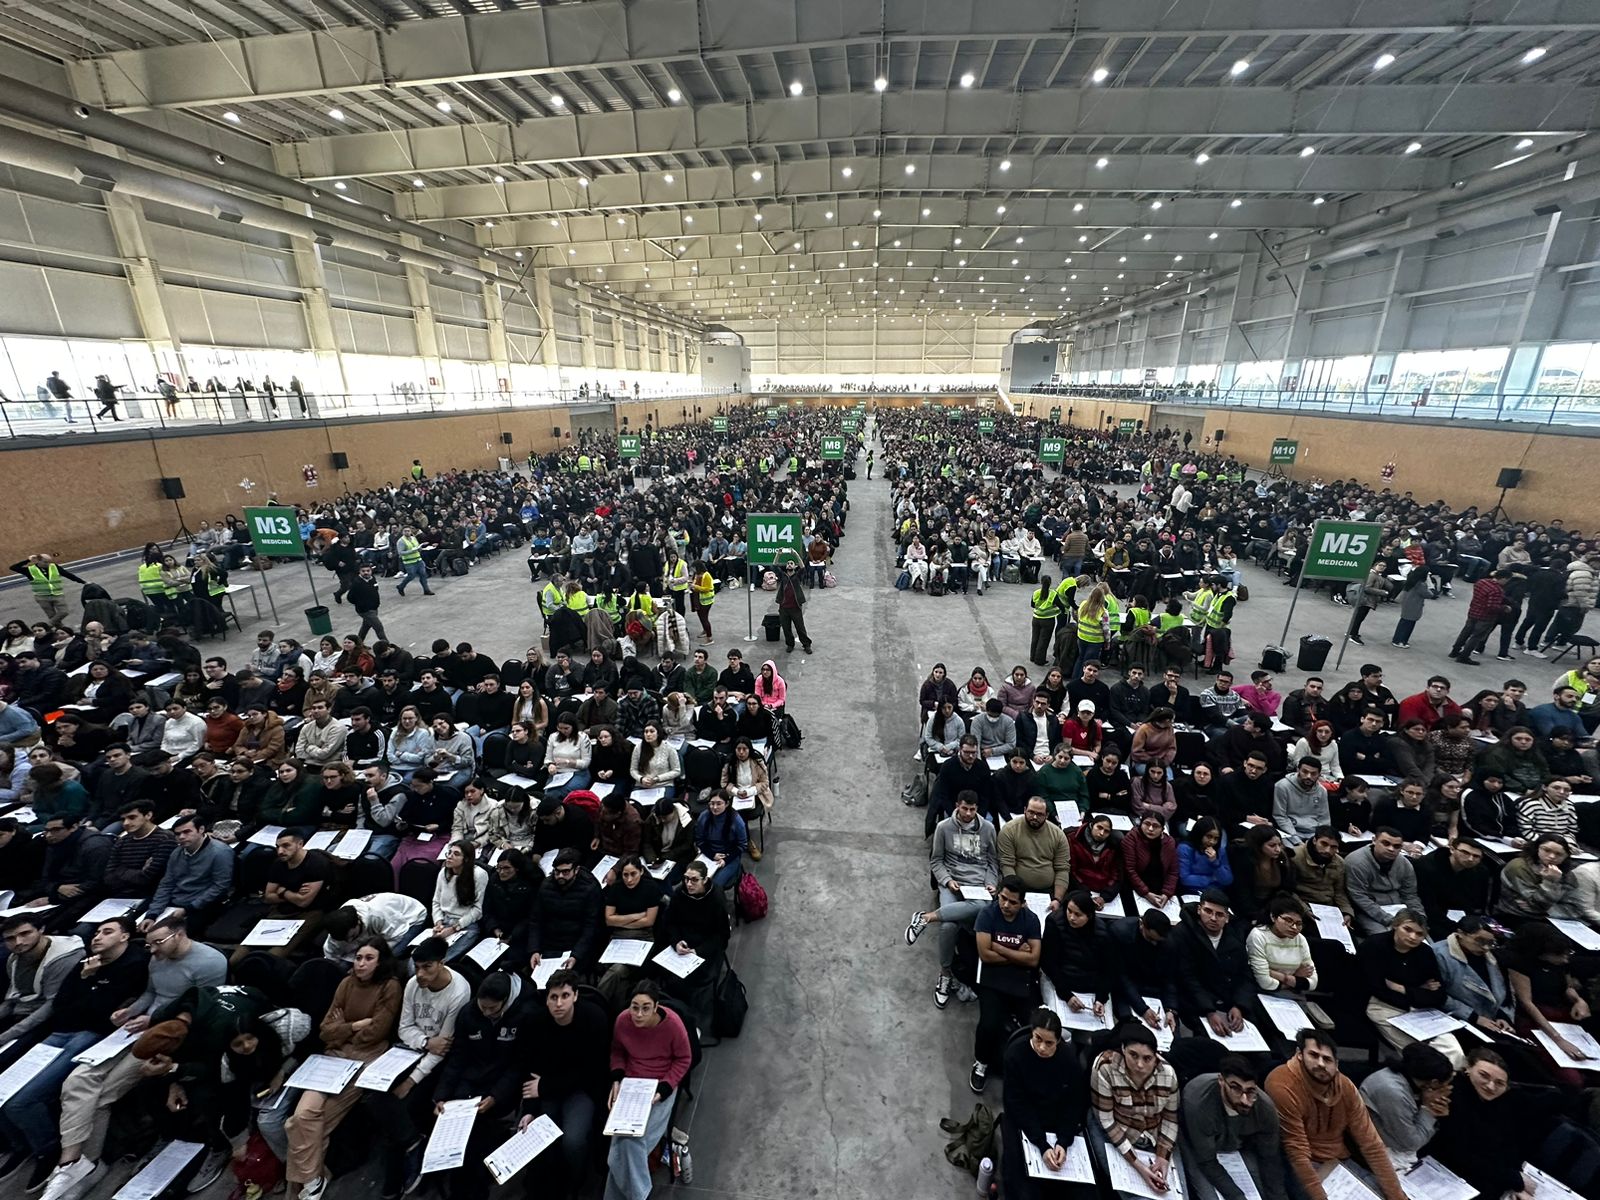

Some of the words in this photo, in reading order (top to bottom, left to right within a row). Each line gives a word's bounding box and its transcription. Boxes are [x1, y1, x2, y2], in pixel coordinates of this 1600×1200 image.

[622, 440, 636, 448] M7
[825, 441, 840, 450] M8
[1044, 442, 1060, 452] M9
[1272, 446, 1296, 454] M10
[254, 516, 292, 535] M3
[756, 524, 794, 543] M4
[1320, 532, 1370, 556] M5
[1317, 558, 1358, 568] MEDICINA
